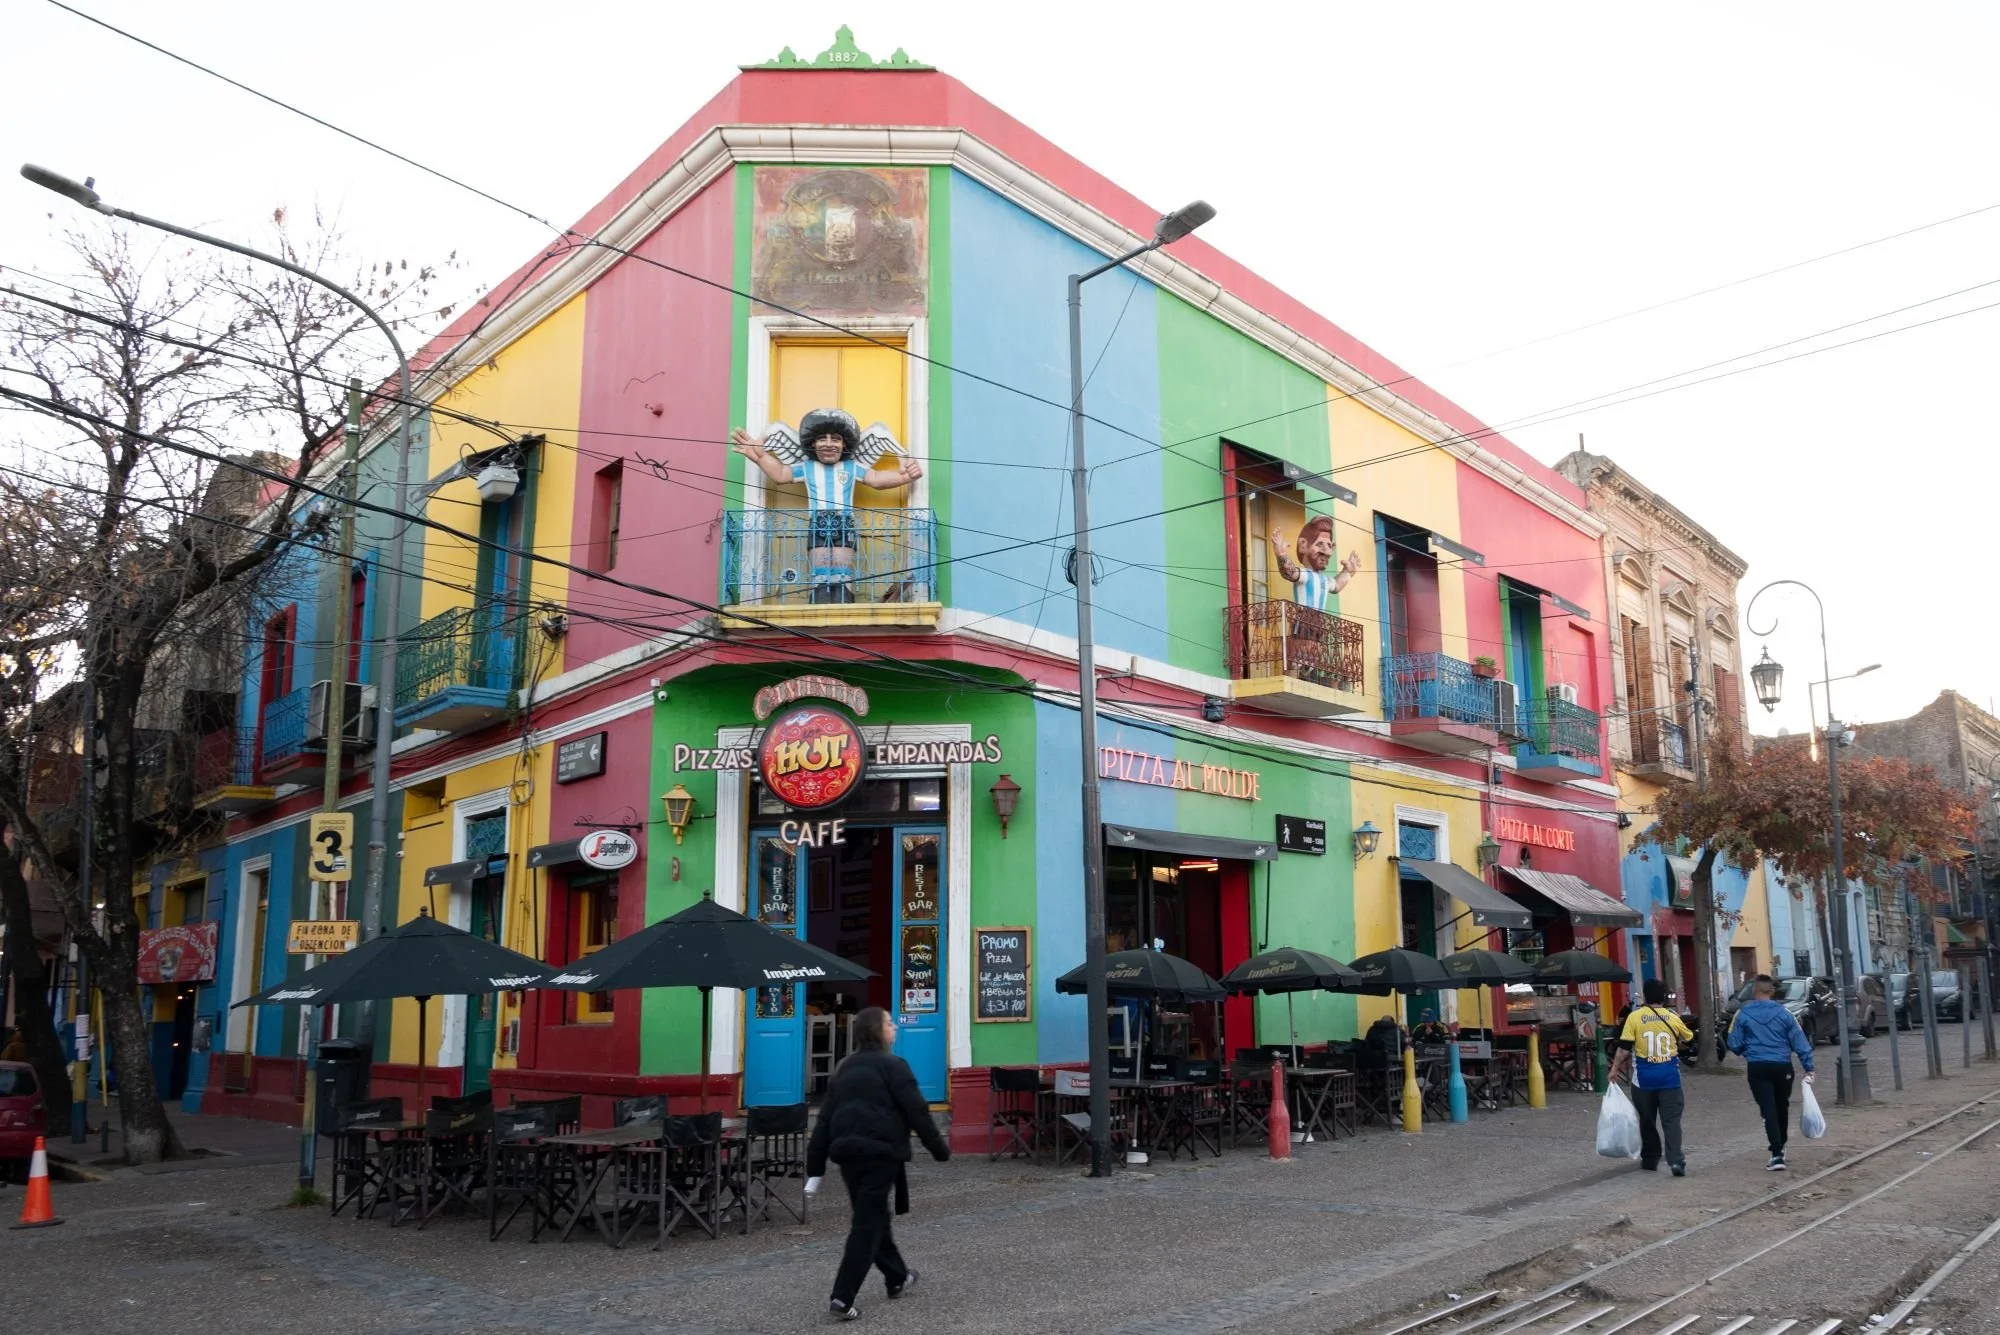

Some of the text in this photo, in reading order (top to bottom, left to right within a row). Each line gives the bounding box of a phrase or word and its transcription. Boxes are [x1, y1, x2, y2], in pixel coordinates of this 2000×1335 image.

[828, 51, 859, 62] 1887
[753, 674, 869, 721] CAMINITO
[673, 743, 753, 773] PIZZAS
[875, 735, 1002, 766] EMPANADAS
[1104, 746, 1262, 801] PIZZA AL MOLDE
[780, 818, 848, 847] CAFE
[1501, 817, 1576, 852] PIZZA AL CORTE
[314, 829, 343, 874] 3
[772, 866, 783, 901] RESTO
[914, 863, 925, 898] RESTO
[763, 901, 789, 914] BAR
[907, 899, 933, 912] BAR
[341, 925, 352, 936] DE
[980, 934, 1018, 950] PROMO
[908, 952, 932, 961] TANGO
[986, 952, 1012, 964] PIZZA
[762, 966, 826, 980] Imperial
[905, 968, 932, 980] SHOW
[1105, 966, 1144, 979] perial
[1248, 960, 1298, 979] Imperial
[1642, 1031, 1671, 1057] 10
